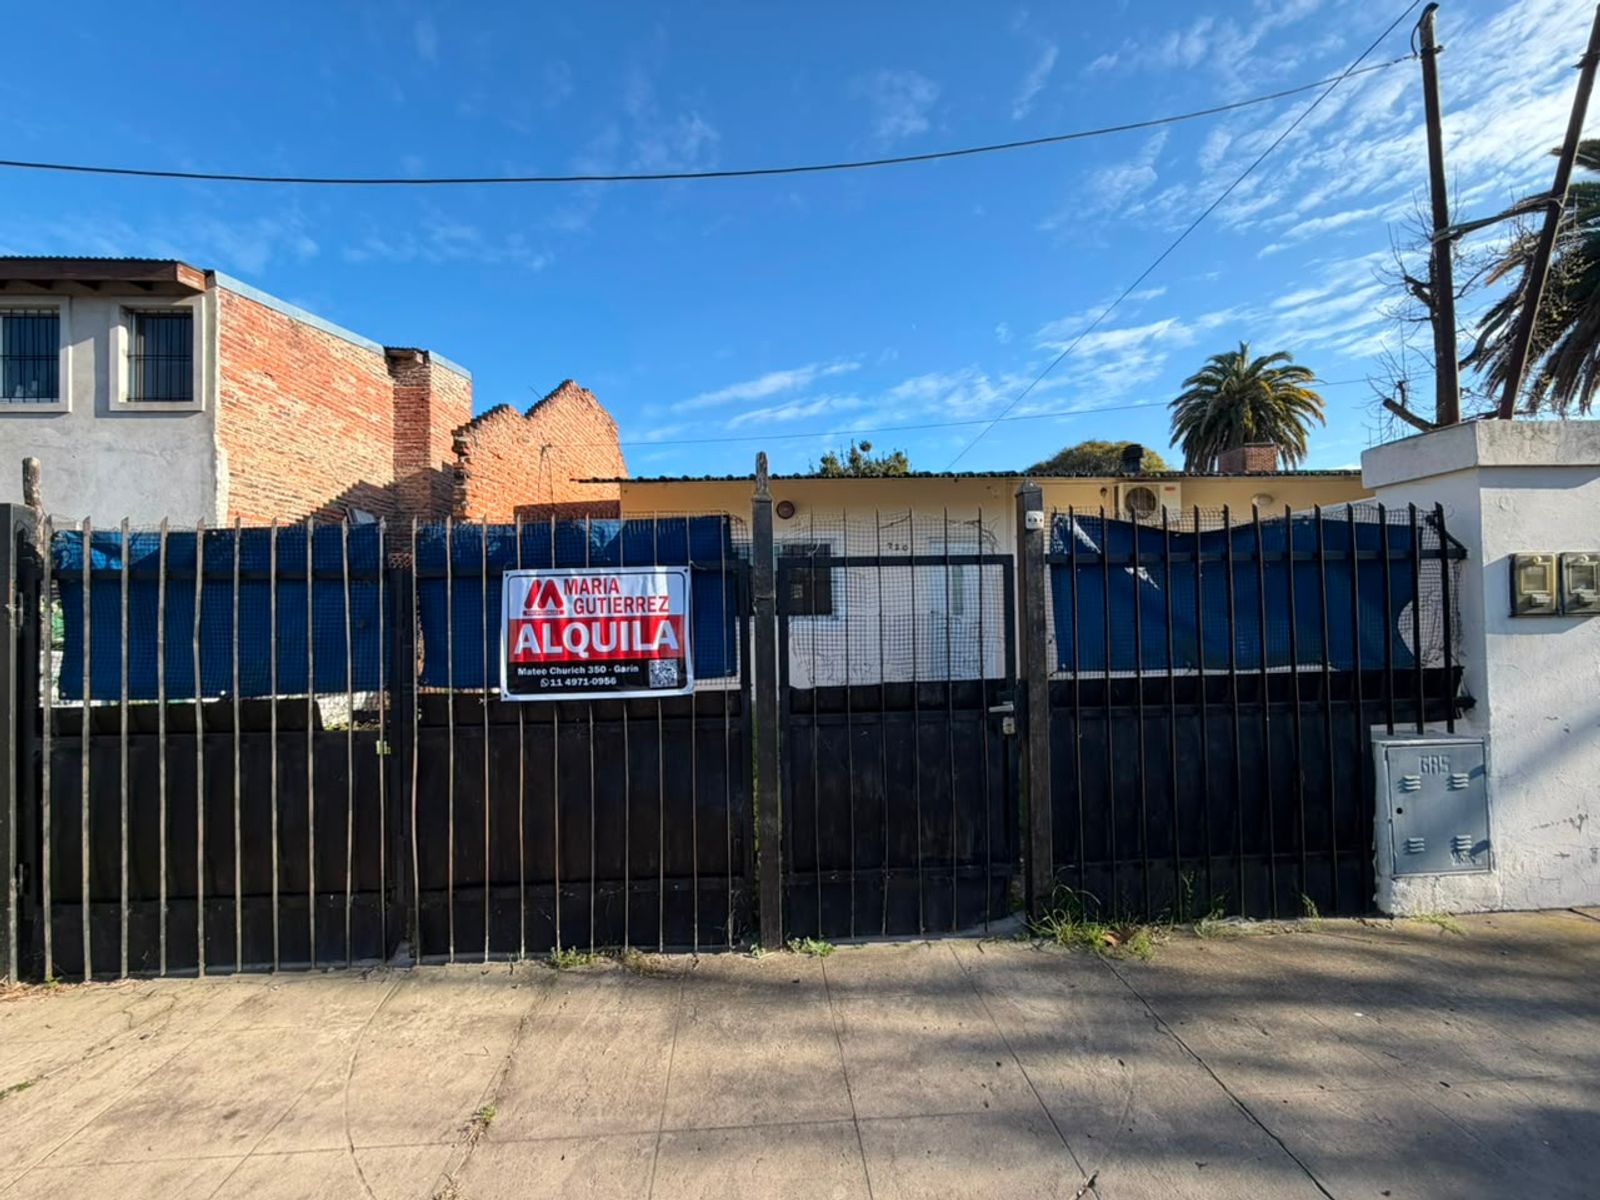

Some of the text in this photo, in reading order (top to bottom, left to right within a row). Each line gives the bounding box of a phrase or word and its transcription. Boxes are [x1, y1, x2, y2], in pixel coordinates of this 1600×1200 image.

[563, 577, 620, 596] MARIA
[573, 596, 670, 615] GUTIERREZ
[514, 620, 679, 658] ALQUILA
[517, 667, 547, 676] Mateo
[549, 666, 586, 675] Churich
[587, 665, 607, 674] 350
[550, 677, 617, 687] 11 4971-0956
[1420, 755, 1450, 775] GAS
